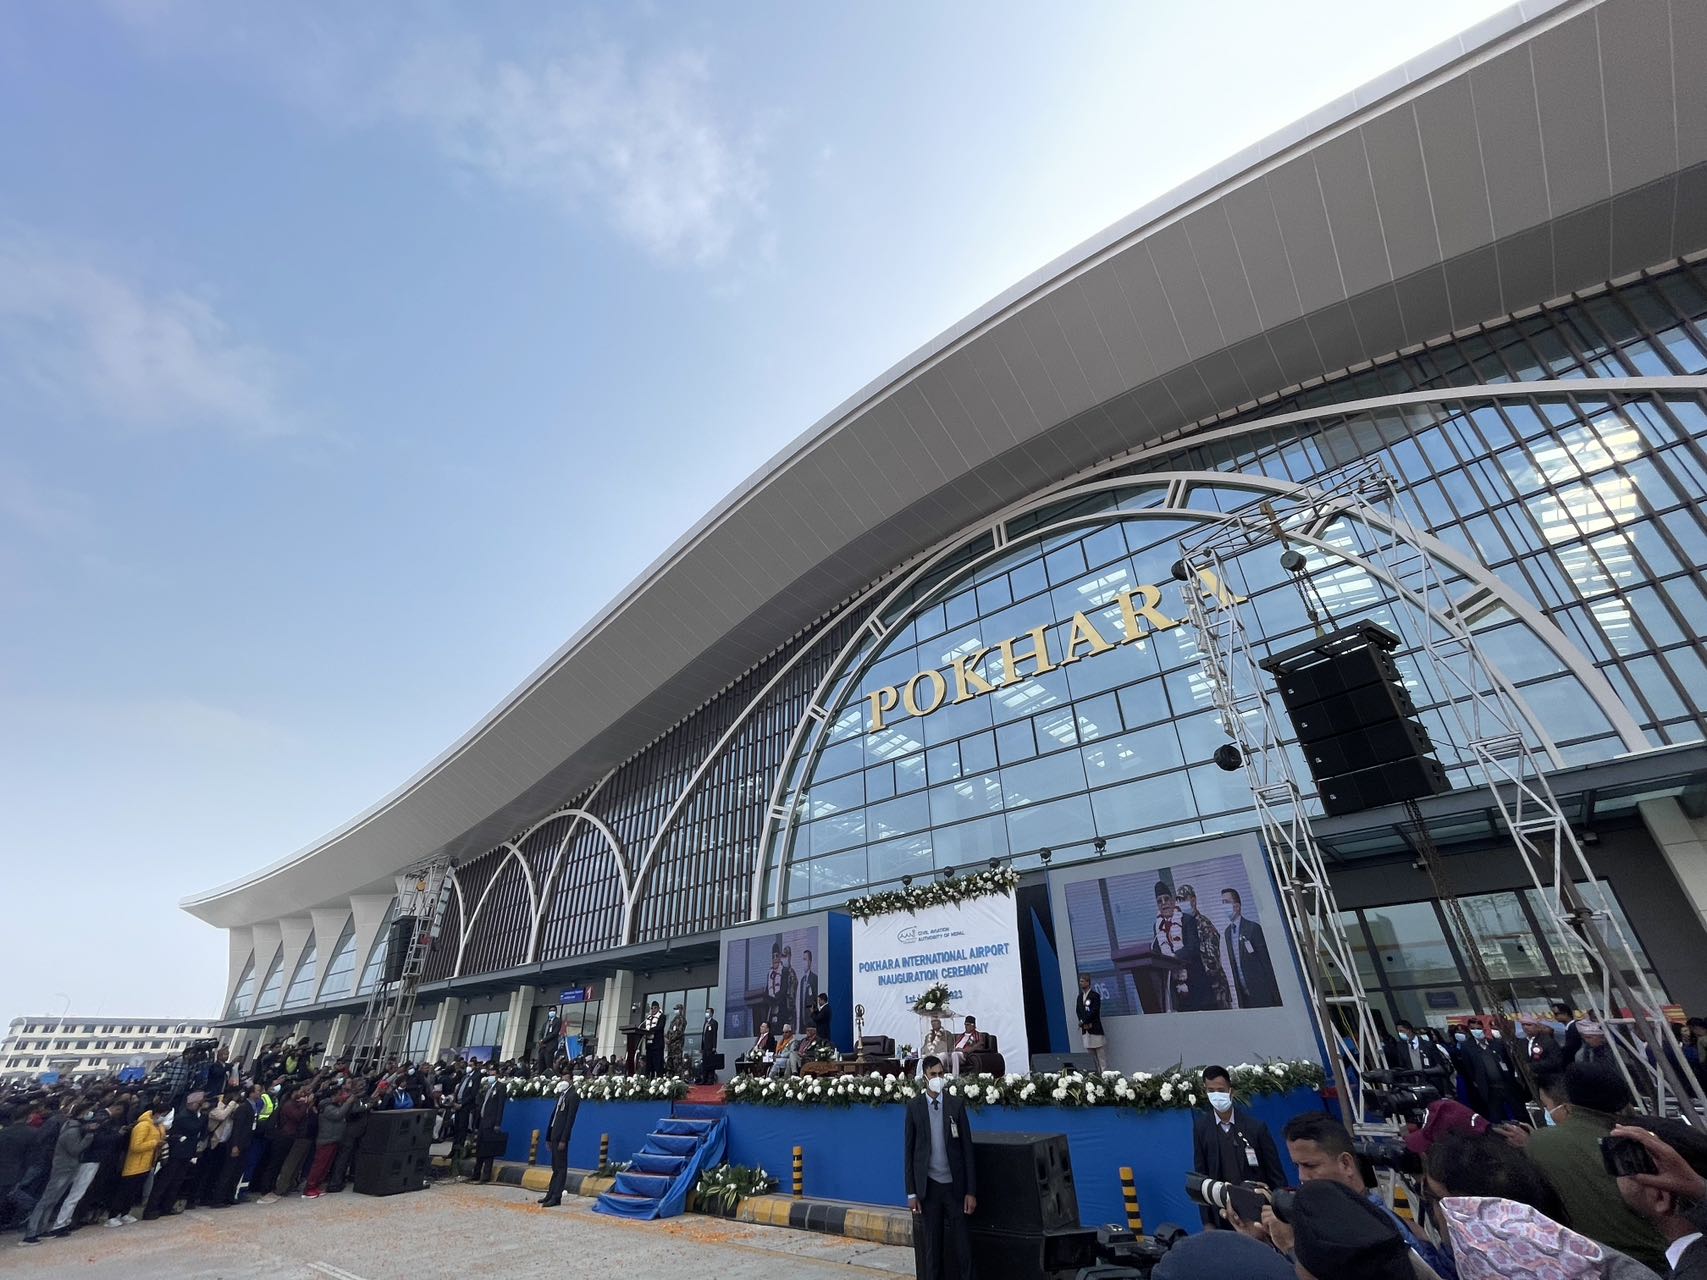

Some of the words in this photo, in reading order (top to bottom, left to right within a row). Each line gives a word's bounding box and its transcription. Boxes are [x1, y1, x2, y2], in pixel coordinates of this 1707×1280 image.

[866, 568, 1249, 734] POKHARA
[918, 934, 943, 942] AUTHORITY
[858, 959, 901, 973] POKHARA
[901, 949, 968, 968] INTERNATIONAL
[969, 943, 1010, 960] AIRPORT
[878, 970, 939, 986] INAUGURATION
[941, 962, 989, 979] CEREMONY
